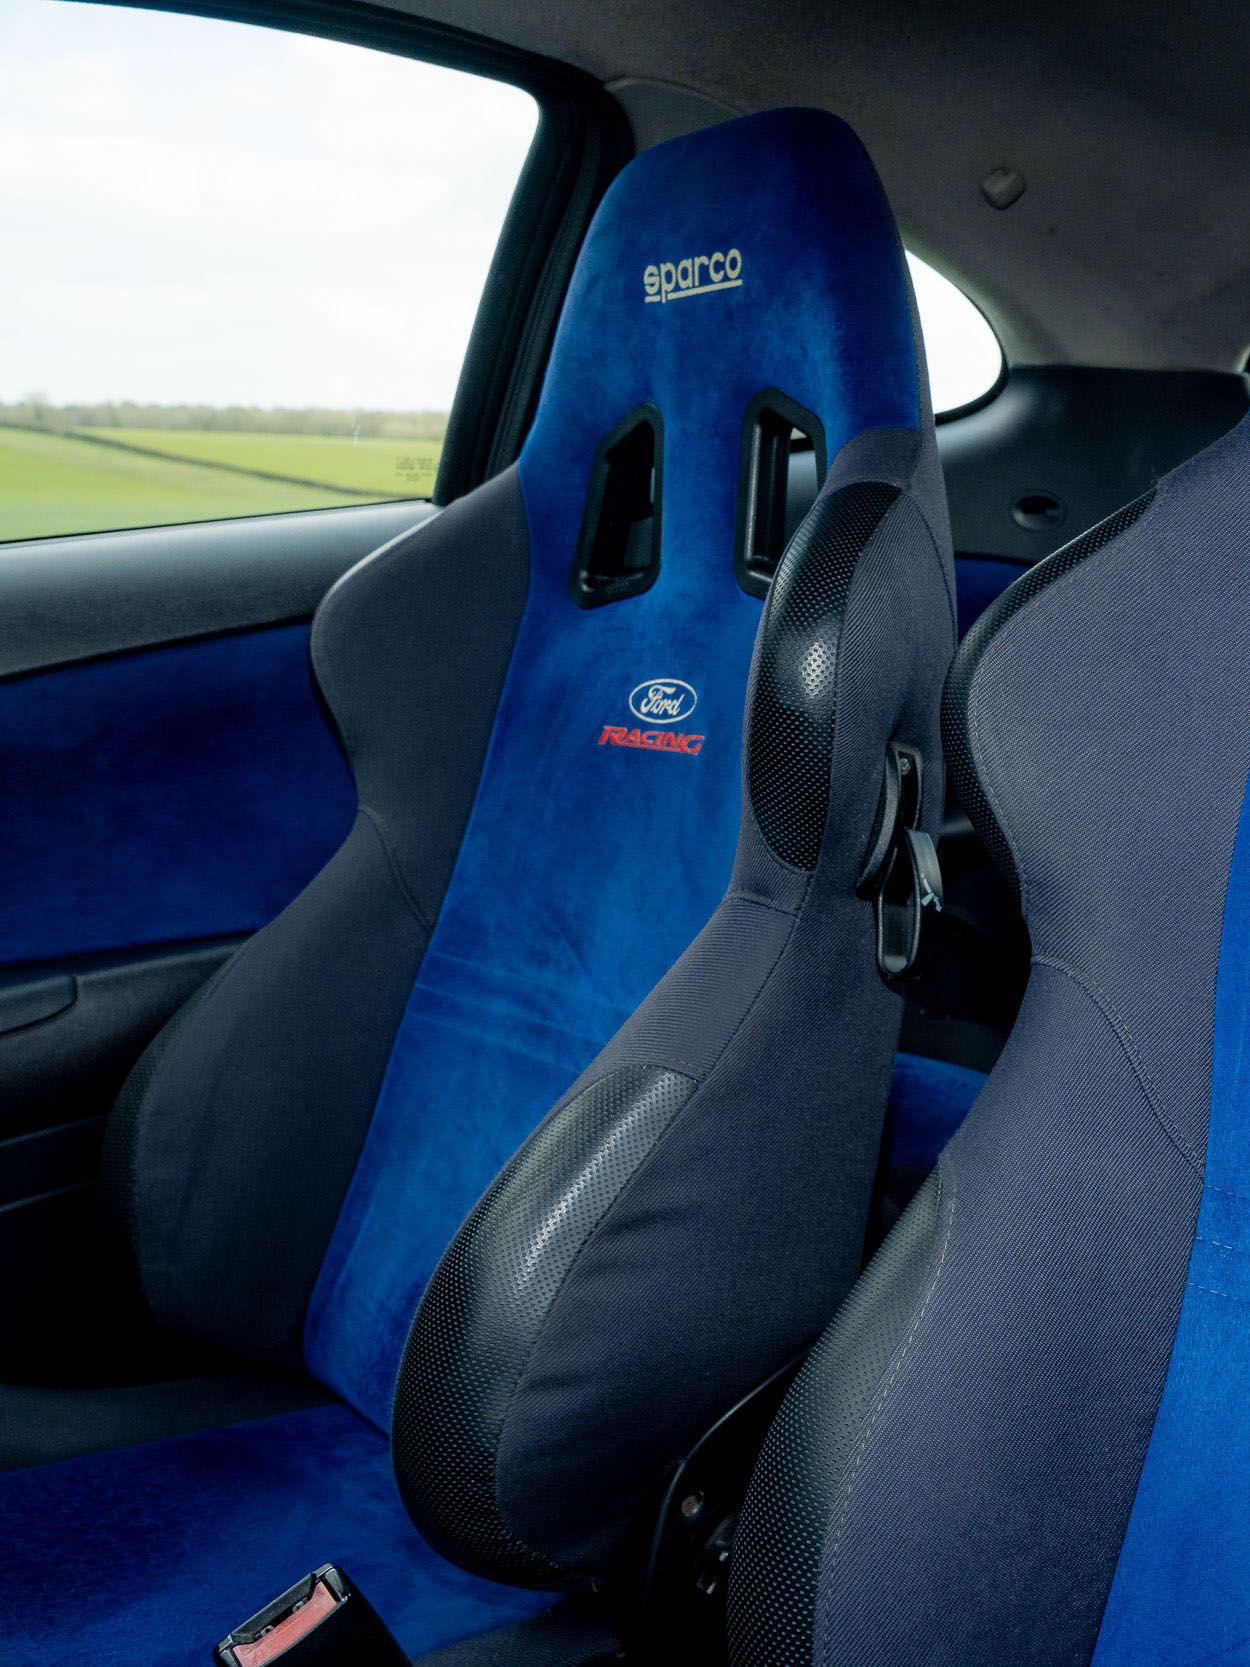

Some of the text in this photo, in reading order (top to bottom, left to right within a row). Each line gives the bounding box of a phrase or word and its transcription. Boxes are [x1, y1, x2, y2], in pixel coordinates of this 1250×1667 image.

[643, 248, 743, 303] sparco
[640, 684, 685, 716] Ford
[597, 725, 705, 755] RACING
